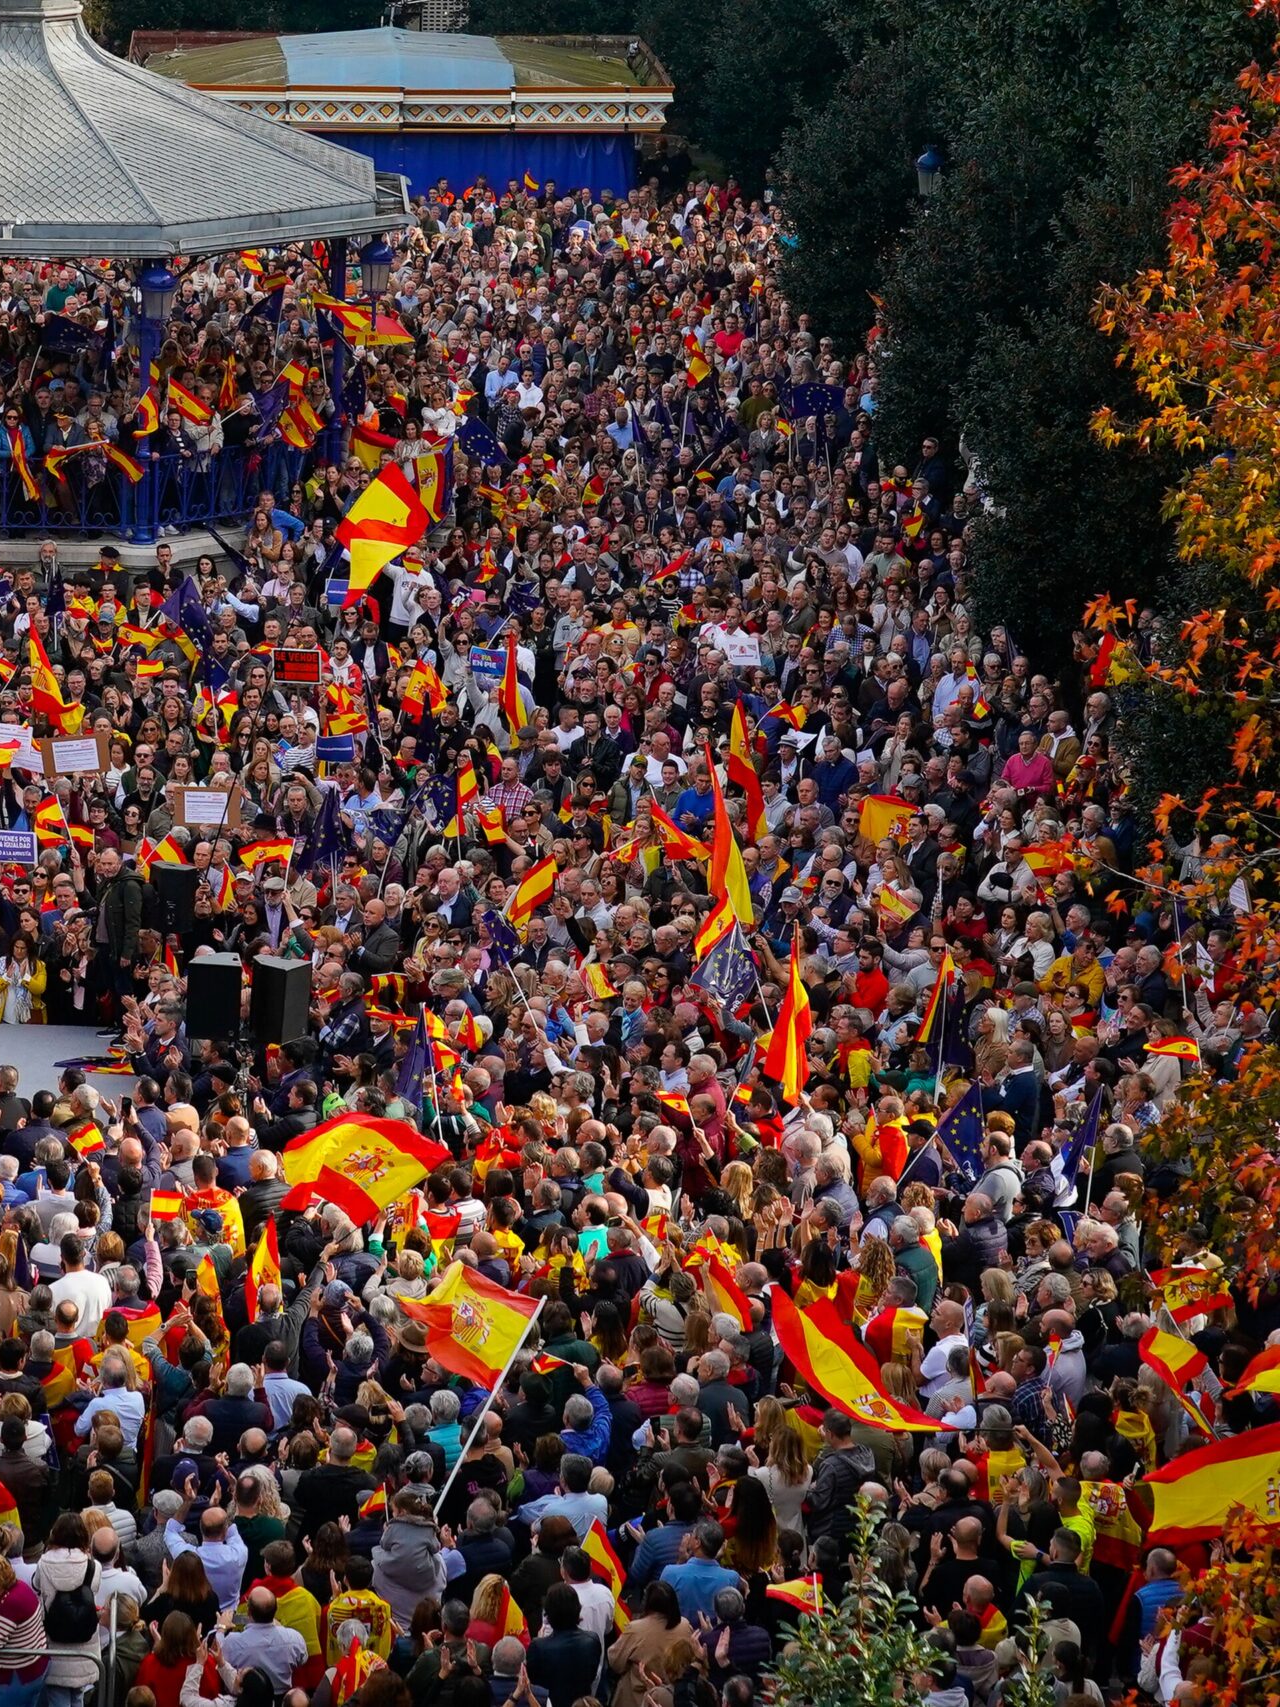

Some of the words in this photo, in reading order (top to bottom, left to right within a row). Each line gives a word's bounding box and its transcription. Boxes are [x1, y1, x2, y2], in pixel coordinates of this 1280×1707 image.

[275, 652, 286, 661] SE
[288, 652, 318, 663] VENDE
[484, 661, 497, 669] PIE
